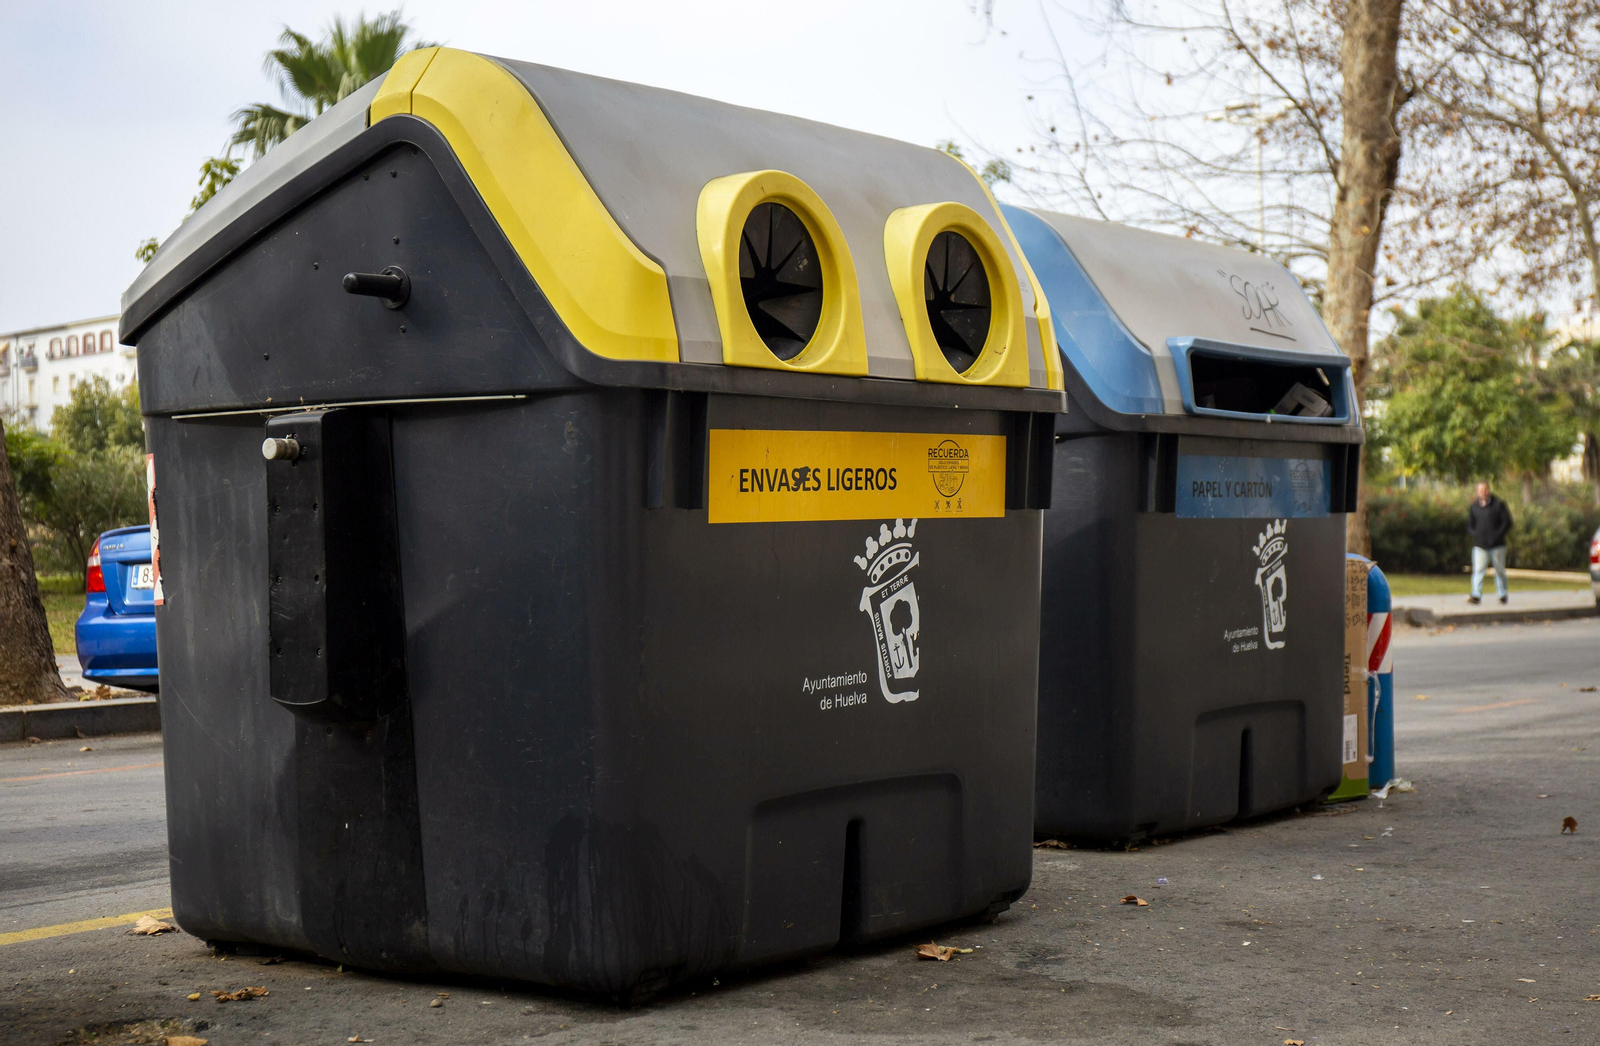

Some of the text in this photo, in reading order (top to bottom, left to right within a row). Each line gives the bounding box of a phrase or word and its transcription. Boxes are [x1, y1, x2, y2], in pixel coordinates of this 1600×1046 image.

[928, 447, 970, 458] RECUERDA
[739, 467, 897, 492] ENVASES LIGEROS
[1192, 481, 1222, 498] PAPEL
[1224, 481, 1231, 497] Y
[1233, 478, 1272, 498] CARTÓN
[881, 589, 889, 599] ET
[1223, 626, 1259, 642] Ayuntamiento
[874, 612, 892, 679] PORTUS MARIS
[1232, 640, 1259, 653] de Huelva
[802, 670, 868, 694] Ayuntamiento
[819, 691, 868, 711] de Huelva
